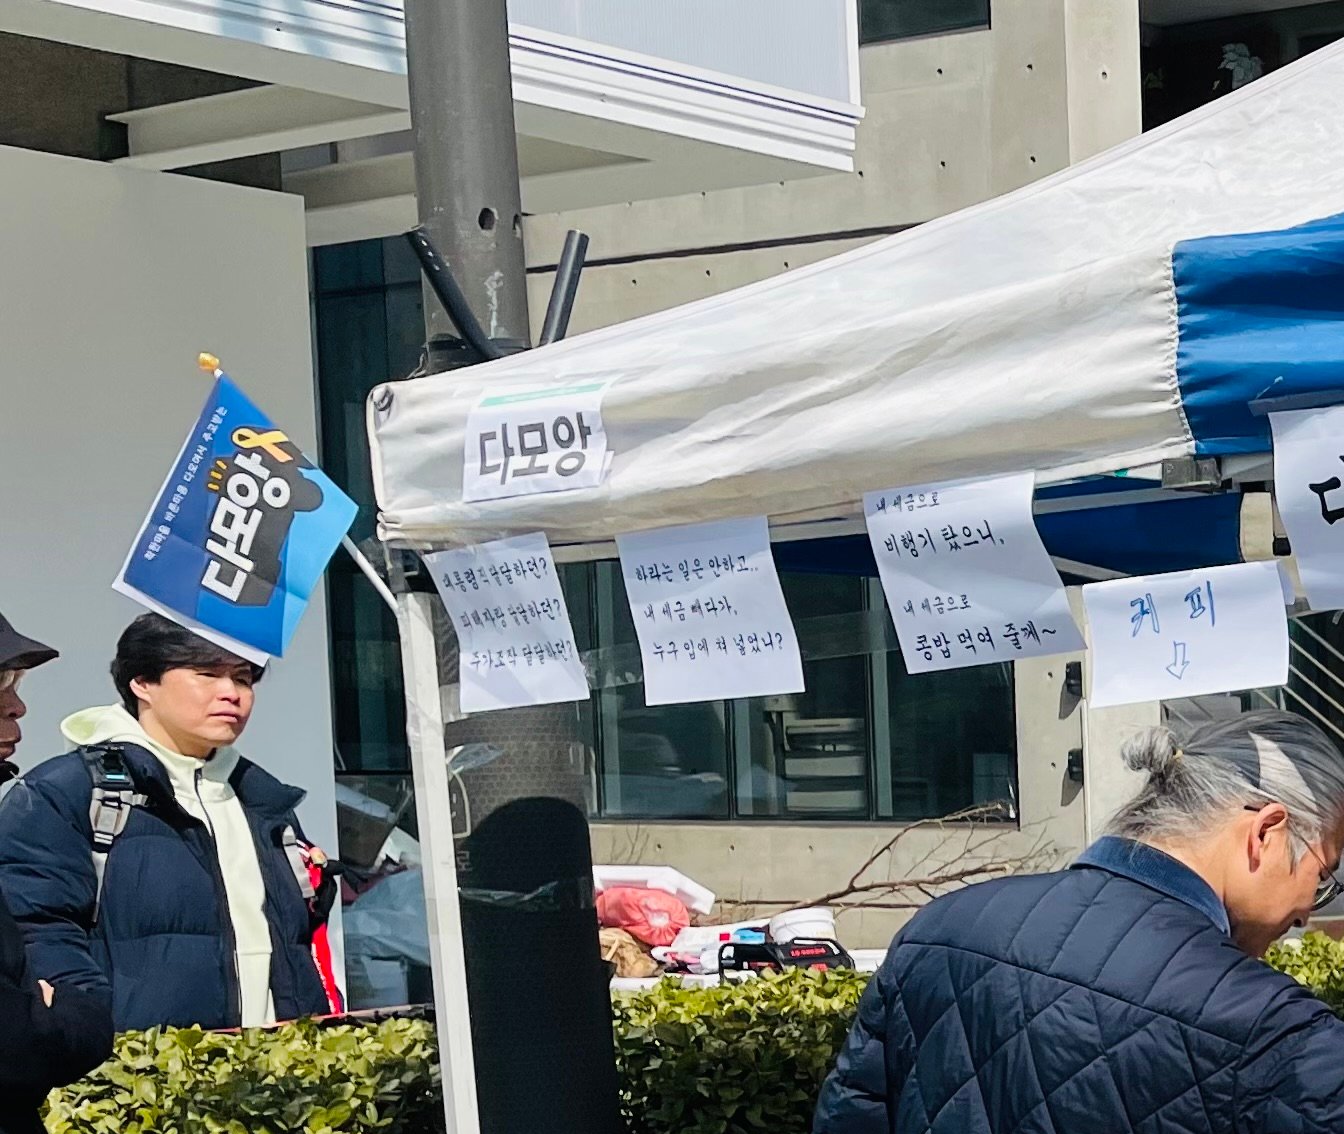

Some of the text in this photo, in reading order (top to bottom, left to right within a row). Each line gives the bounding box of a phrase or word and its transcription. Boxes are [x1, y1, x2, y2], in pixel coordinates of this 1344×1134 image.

[479, 412, 592, 485] 다모앙
[876, 491, 940, 514] 내 세금으로
[201, 452, 291, 602] 다모앙
[884, 527, 936, 558] 비행기
[636, 563, 672, 582] 하라는
[644, 603, 655, 622] 내
[662, 601, 685, 621] 세금
[903, 594, 971, 616] 내 세금으로
[653, 641, 678, 662] 누구
[684, 637, 709, 660] 입에
[916, 631, 951, 661] 콩밥
